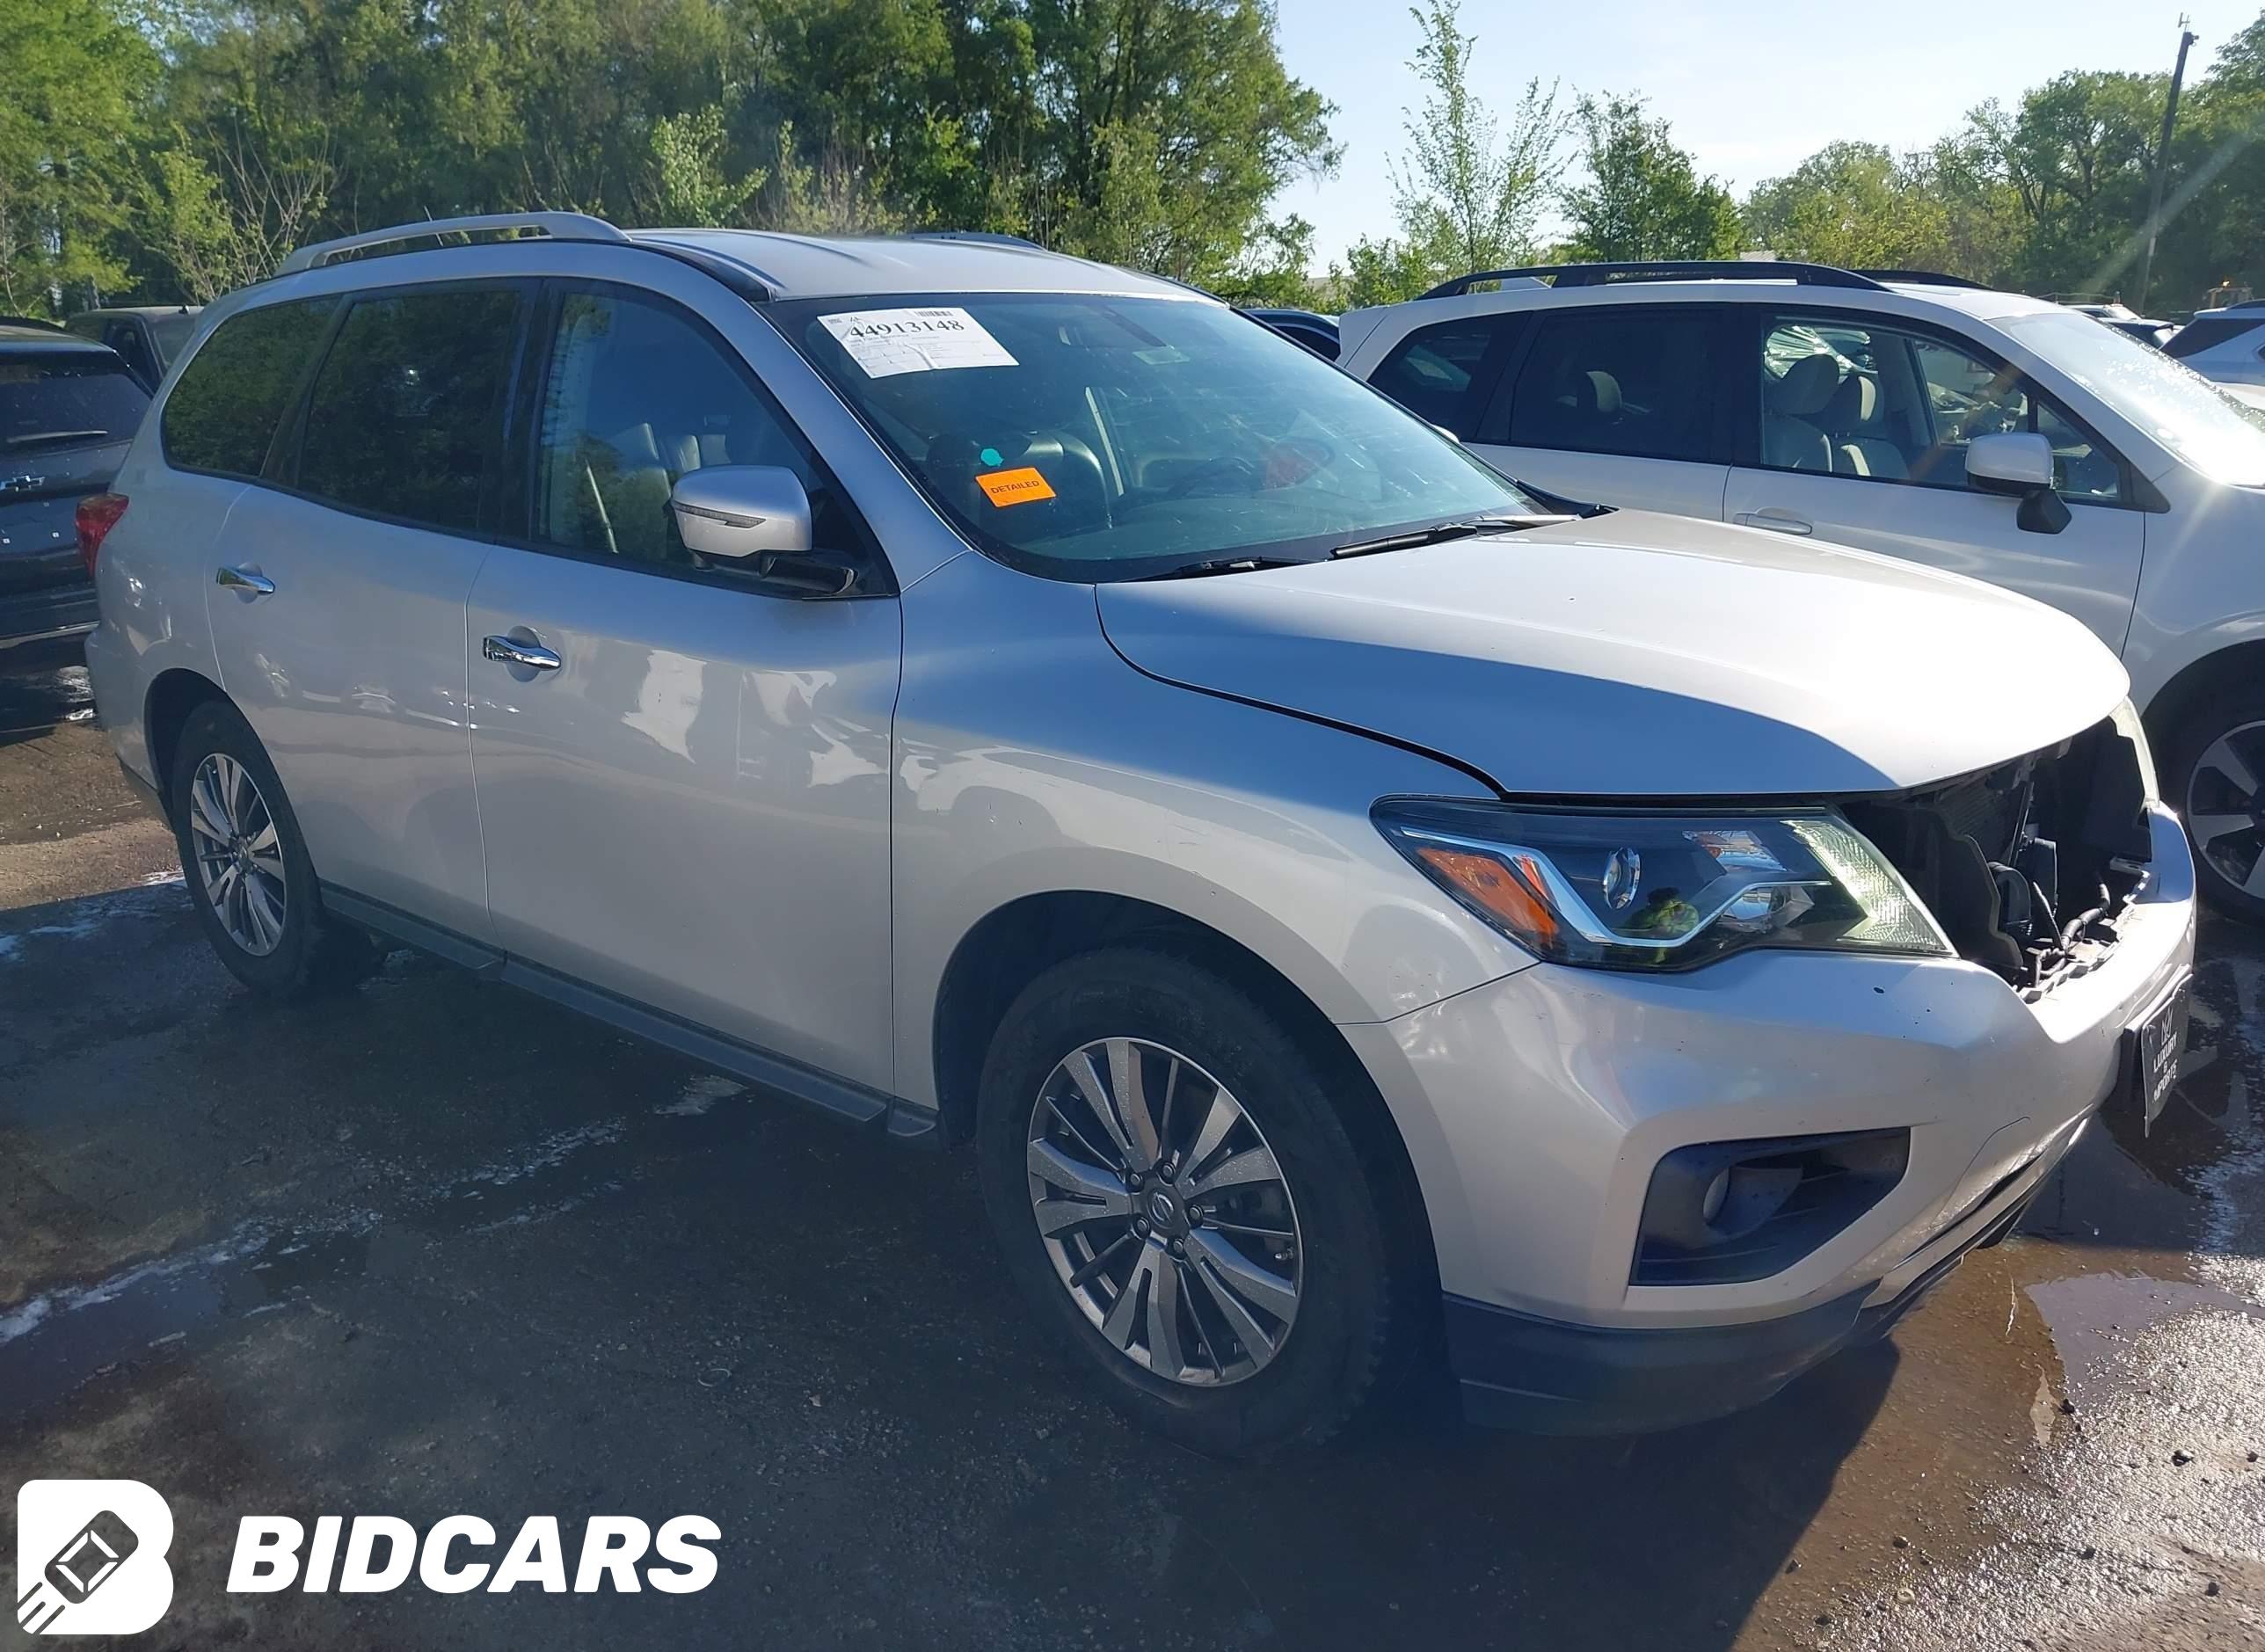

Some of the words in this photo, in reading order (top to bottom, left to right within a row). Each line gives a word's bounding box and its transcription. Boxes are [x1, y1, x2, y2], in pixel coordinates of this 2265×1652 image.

[850, 319, 965, 338] 44913148
[990, 480, 1040, 494] DETAILED
[2153, 1030, 2178, 1073] LUXURY
